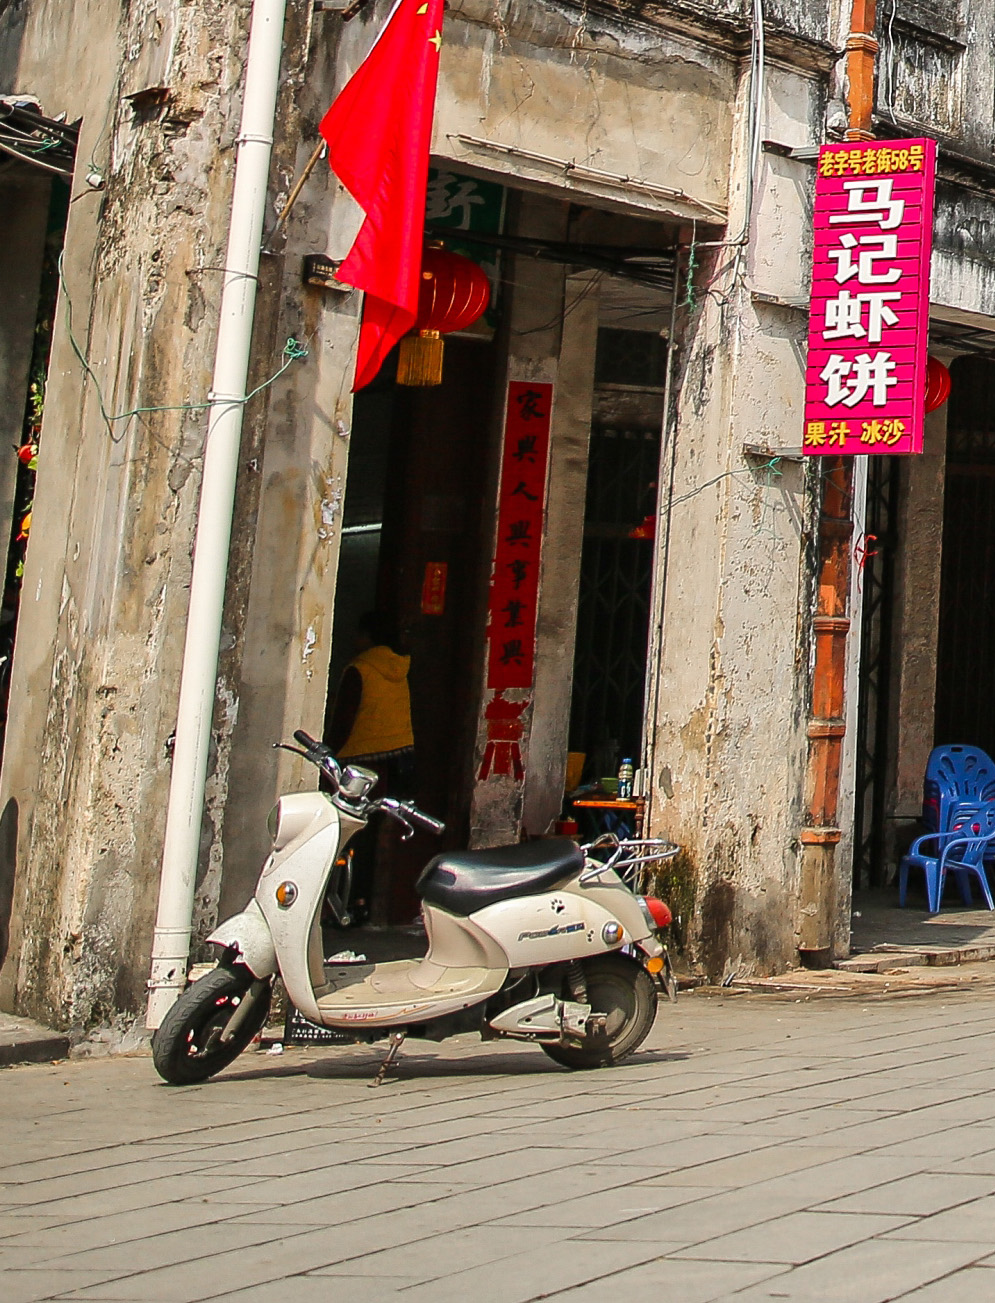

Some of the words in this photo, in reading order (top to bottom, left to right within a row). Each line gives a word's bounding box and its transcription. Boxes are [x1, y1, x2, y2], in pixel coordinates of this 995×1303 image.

[820, 145, 924, 176] 老字号老街58号
[819, 178, 906, 408] 马记虾饼
[804, 421, 851, 446] 果汁
[860, 419, 906, 445] 冰沙
